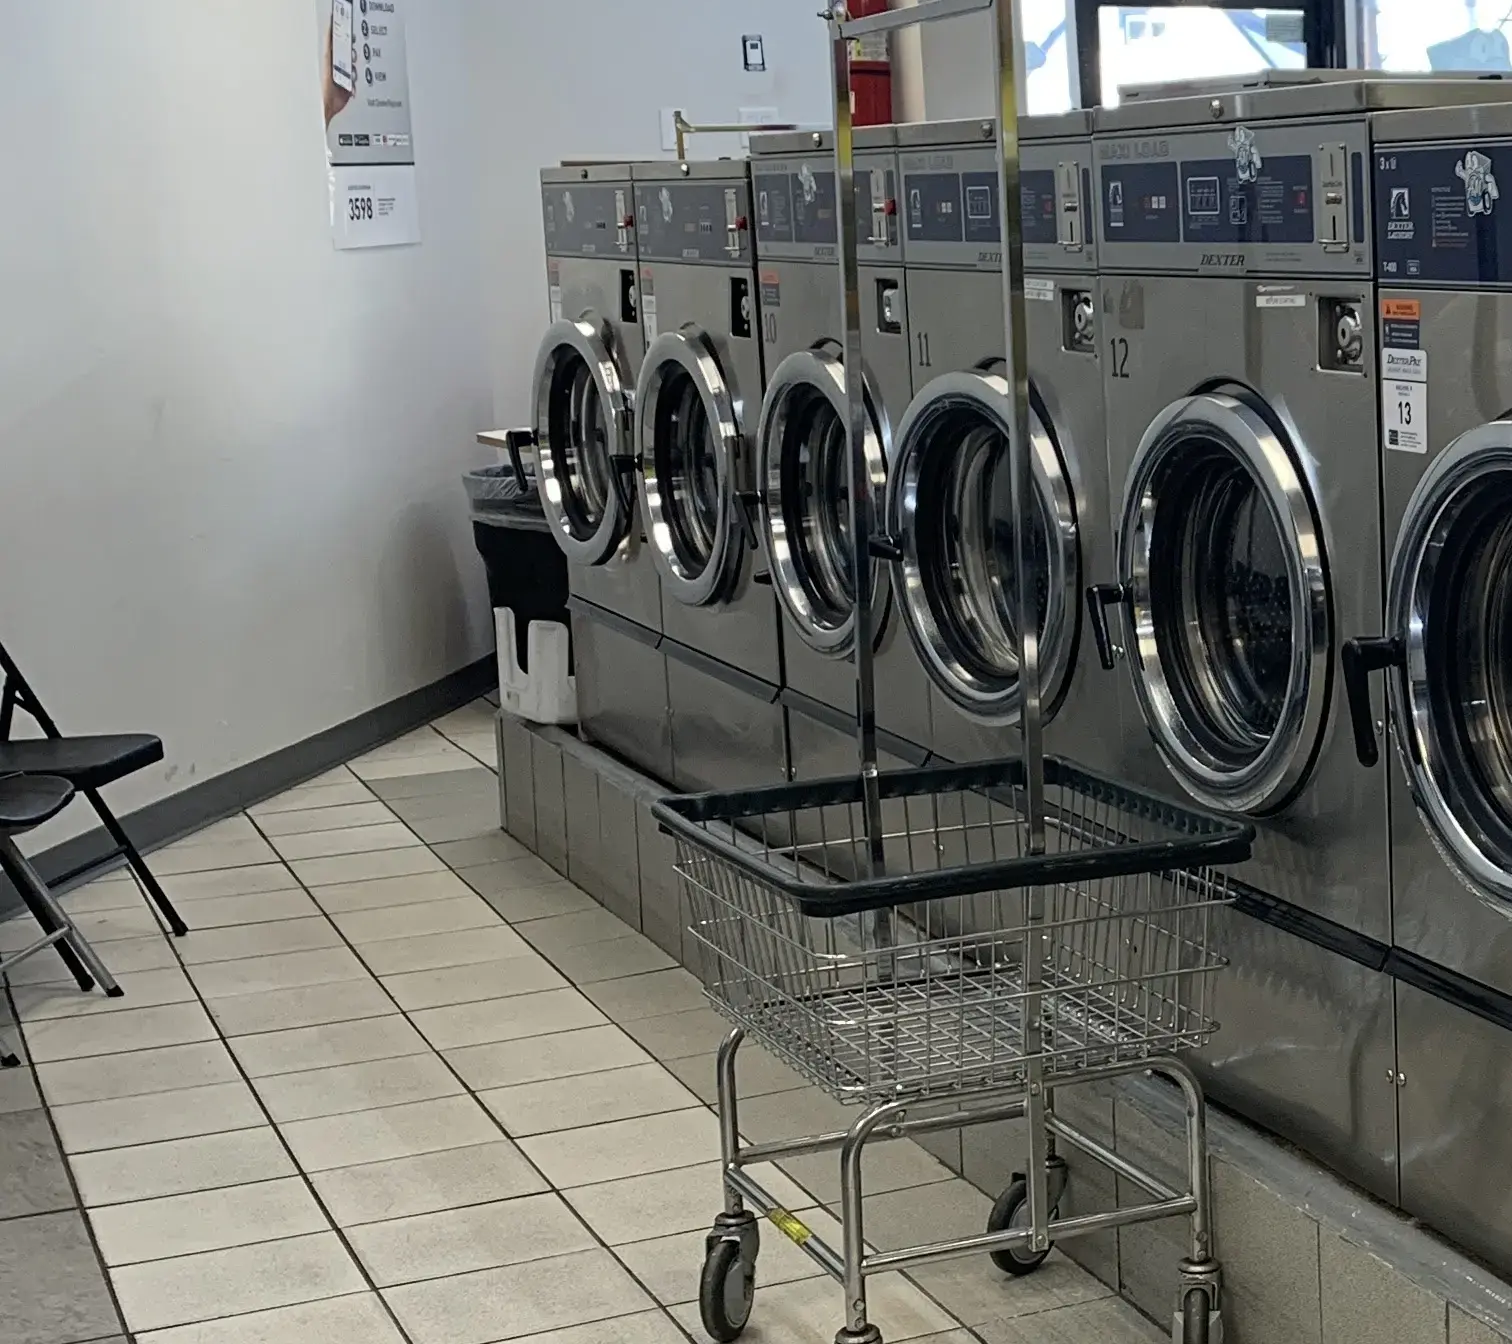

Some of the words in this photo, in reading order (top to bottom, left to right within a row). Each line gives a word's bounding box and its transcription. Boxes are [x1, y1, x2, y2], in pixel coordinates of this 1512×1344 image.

[348, 196, 373, 222] 3598
[1200, 254, 1245, 267] DEXTER
[764, 312, 777, 344] 10
[918, 331, 931, 367] 11
[1109, 337, 1130, 379] 12
[1398, 400, 1412, 426] 13
